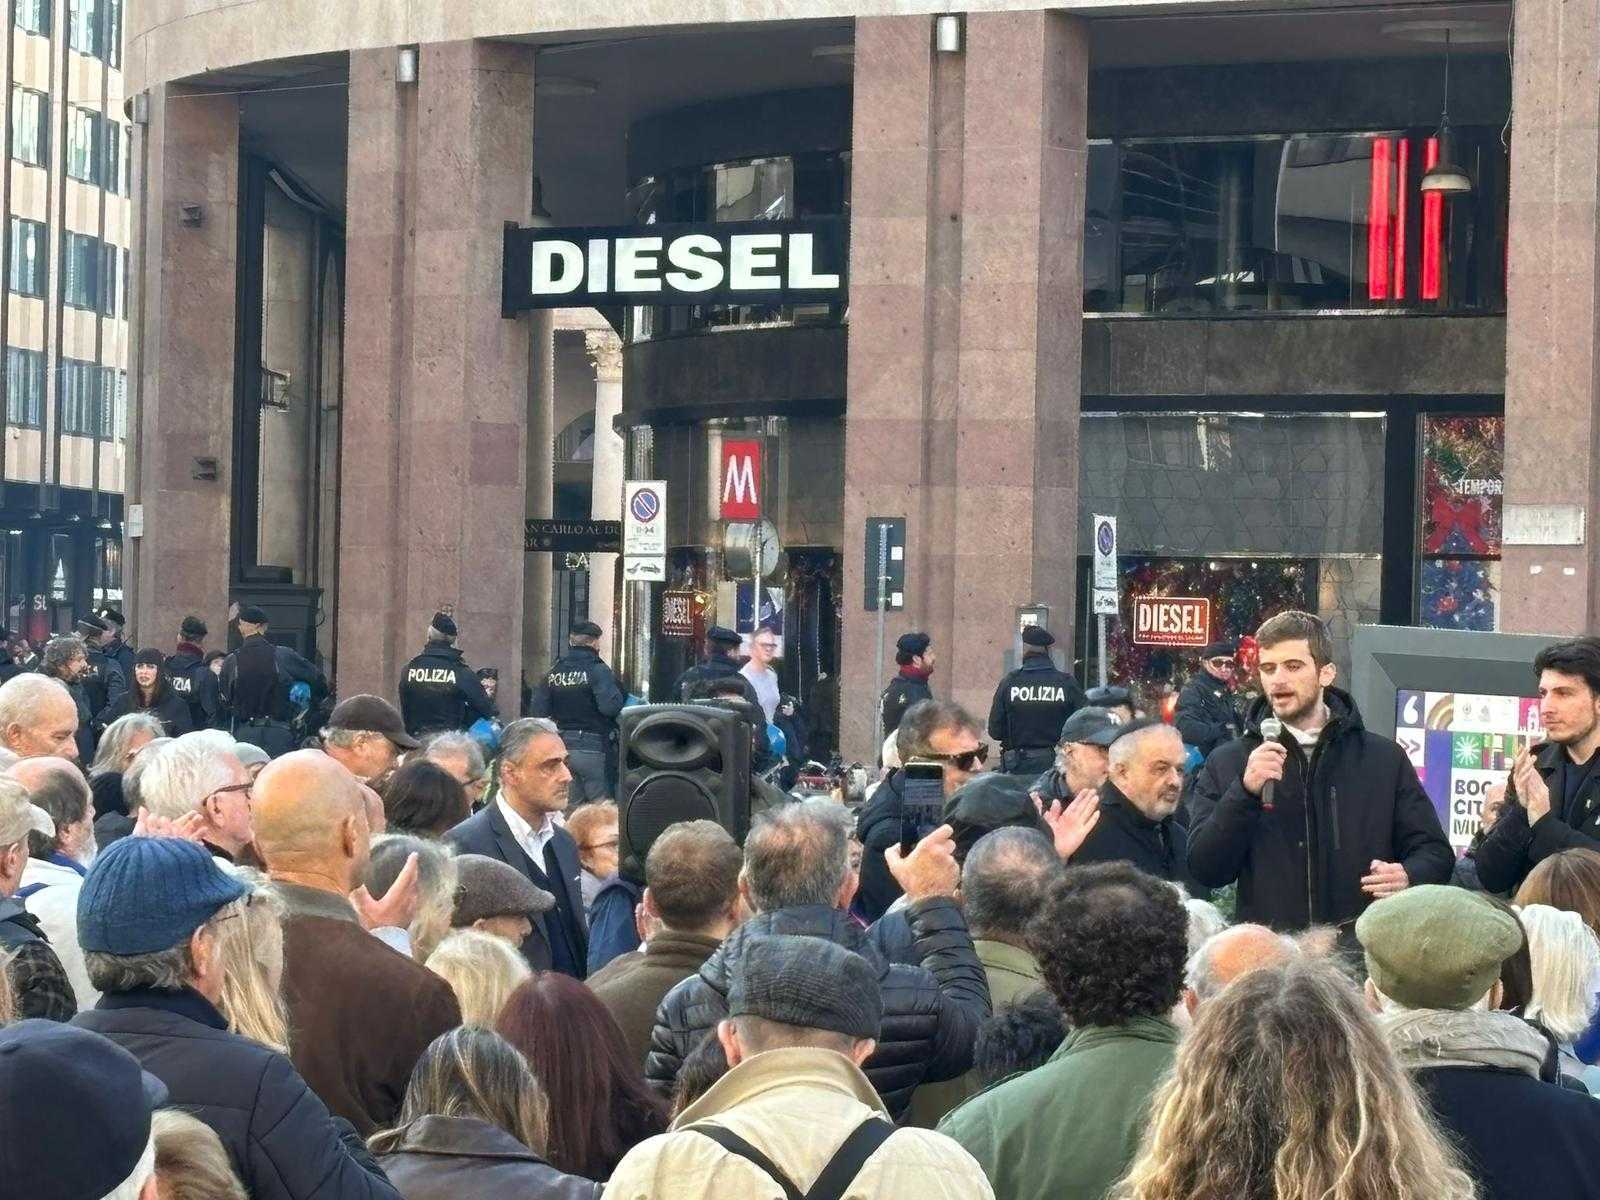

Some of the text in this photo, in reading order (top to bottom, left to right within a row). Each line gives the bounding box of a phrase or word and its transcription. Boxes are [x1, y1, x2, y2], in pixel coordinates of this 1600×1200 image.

[531, 233, 840, 295] DIESEL
[723, 454, 757, 504] M
[1458, 479, 1503, 495] TEMPOR
[1139, 603, 1205, 634] DIESEL
[407, 668, 456, 684] POLIZIA
[548, 671, 588, 687] POLIZIA
[1010, 686, 1065, 702] POLIZIA
